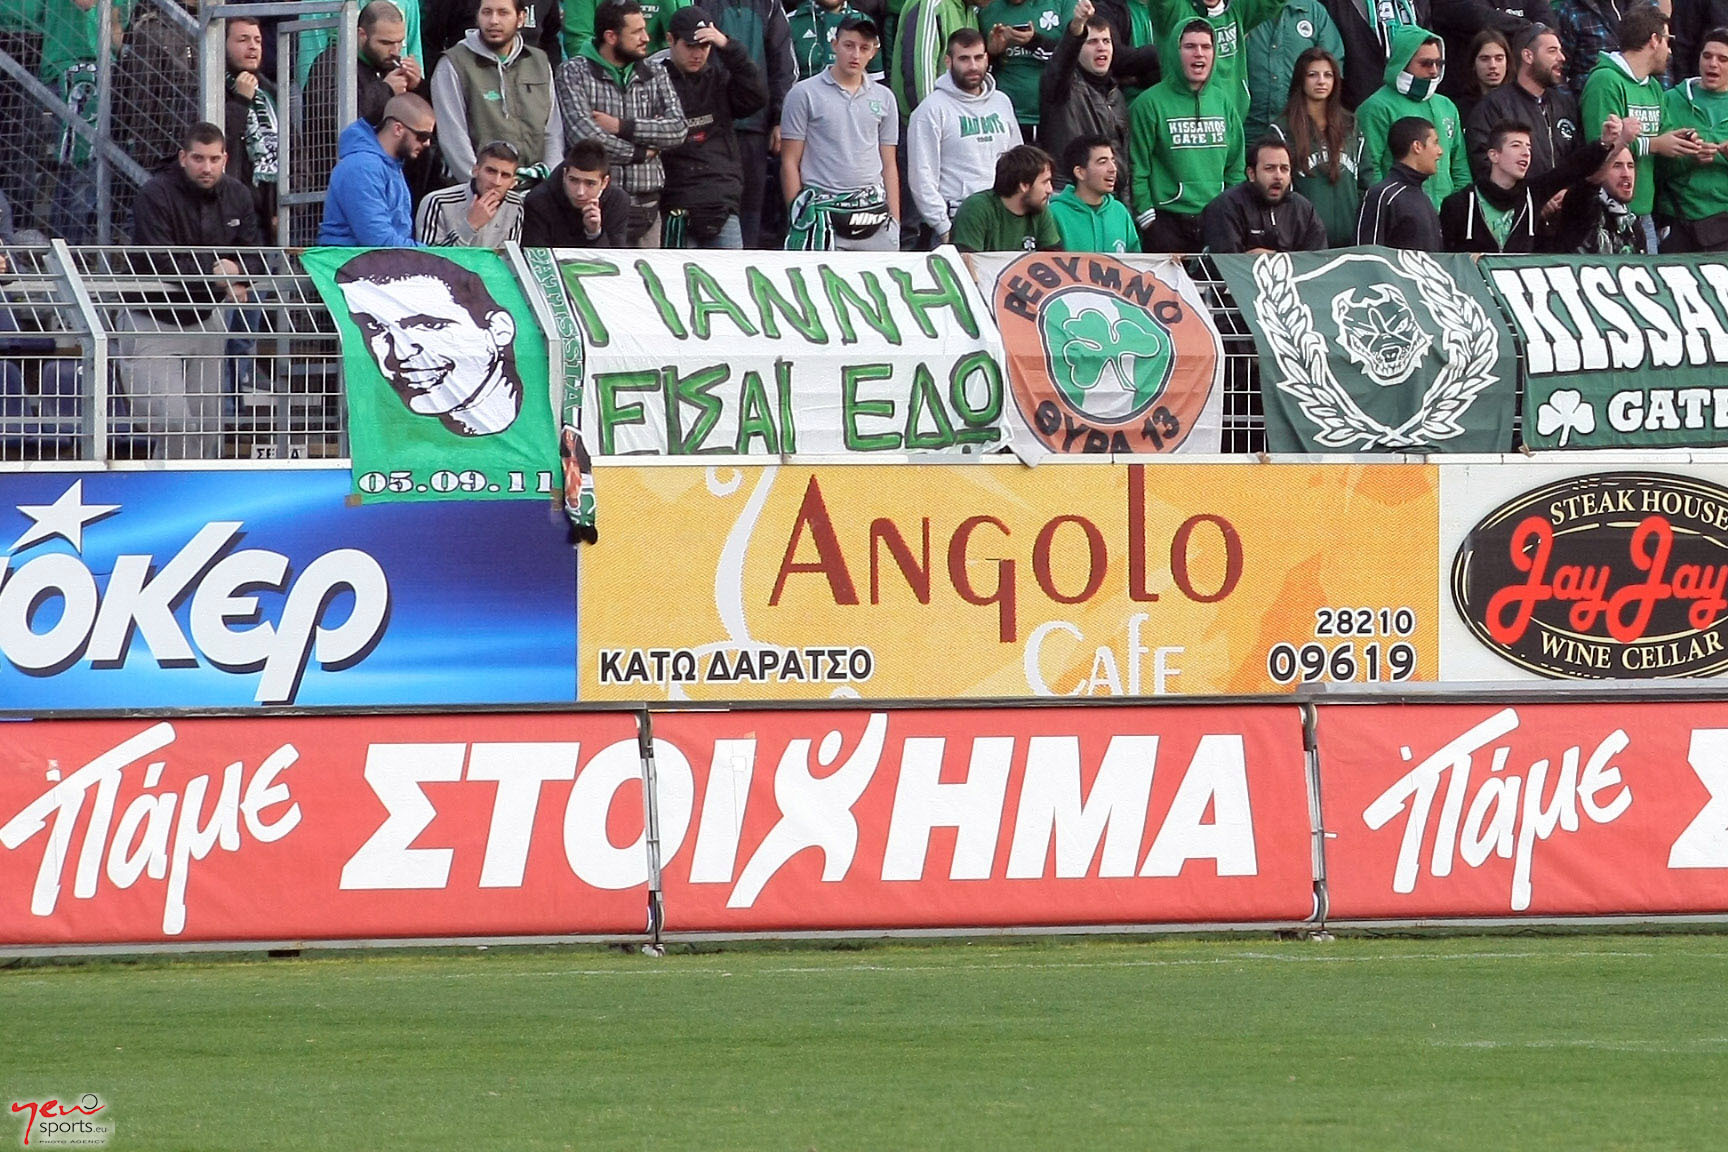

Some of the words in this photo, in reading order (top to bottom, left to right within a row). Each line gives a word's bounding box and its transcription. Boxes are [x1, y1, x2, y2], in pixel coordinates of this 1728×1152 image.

[1168, 120, 1227, 135] KISSAMOS
[1172, 133, 1207, 145] GATE
[848, 211, 889, 226] NIKE
[556, 253, 983, 349] ΓΙΑΝΝΗ
[1004, 256, 1184, 324] ΡΕΘΥΜΝΟ
[841, 351, 1006, 453] ΕΔΩ
[1141, 405, 1181, 451] 13
[357, 470, 556, 496] 05.09.11
[1549, 489, 1637, 527] STEAK
[1484, 514, 1611, 645] Jay
[1316, 608, 1415, 637] 28210
[598, 649, 698, 685] ΚΑΤΩ
[703, 648, 875, 683] ΔΑΡΑΤΣΟ
[1267, 640, 1418, 684] 09619
[1539, 630, 1613, 671] WINE
[1620, 629, 1725, 671] CELLAR
[0, 721, 303, 937] Πάμε
[1362, 707, 1634, 912] Πάμε
